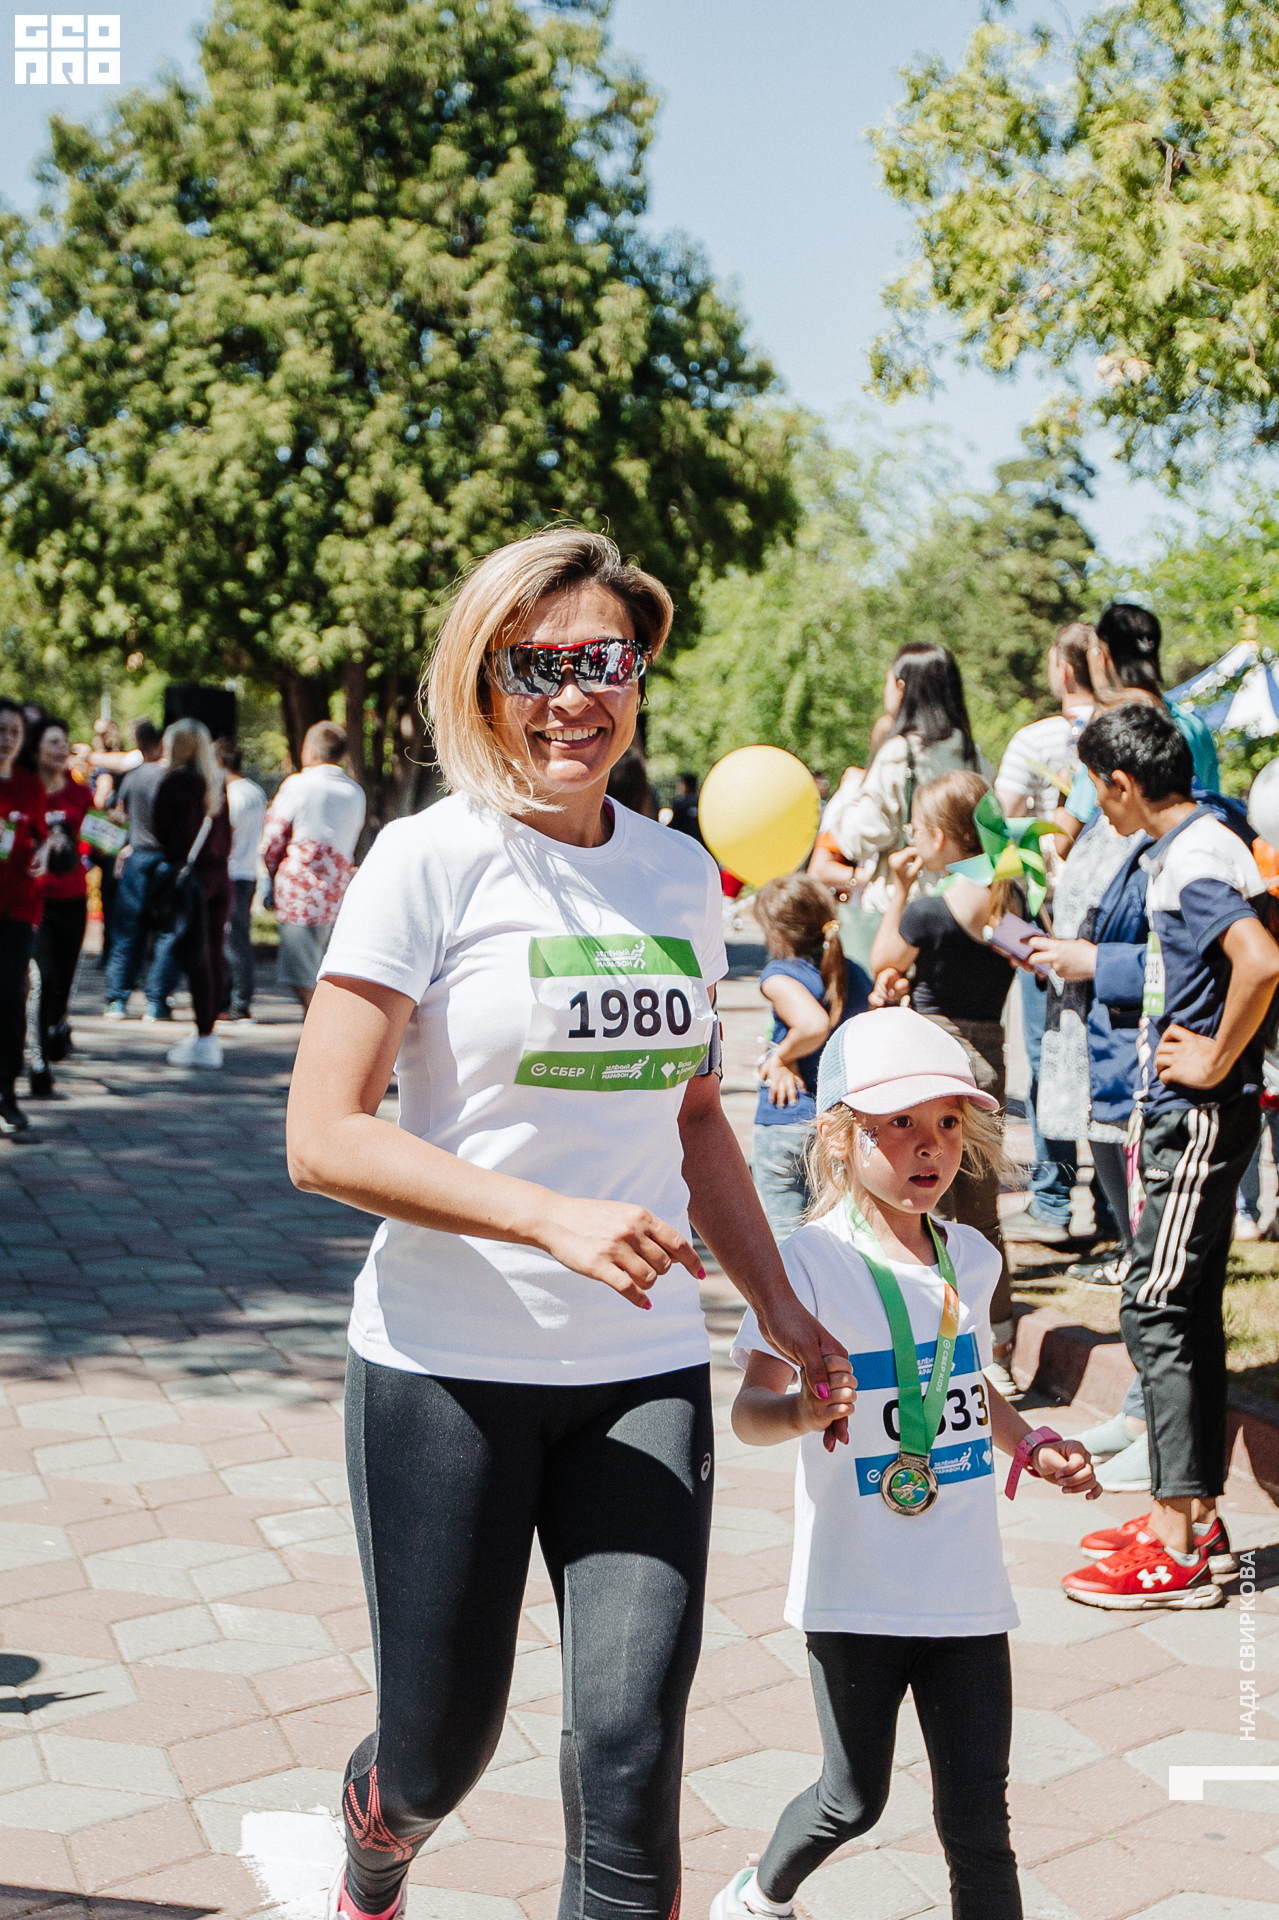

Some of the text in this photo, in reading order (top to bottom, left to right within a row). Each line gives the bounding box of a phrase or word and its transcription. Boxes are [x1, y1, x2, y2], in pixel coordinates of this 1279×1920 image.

[568, 988, 691, 1038] 1980
[550, 1066, 585, 1077] СБЕР
[935, 1372, 945, 1393] KIDS
